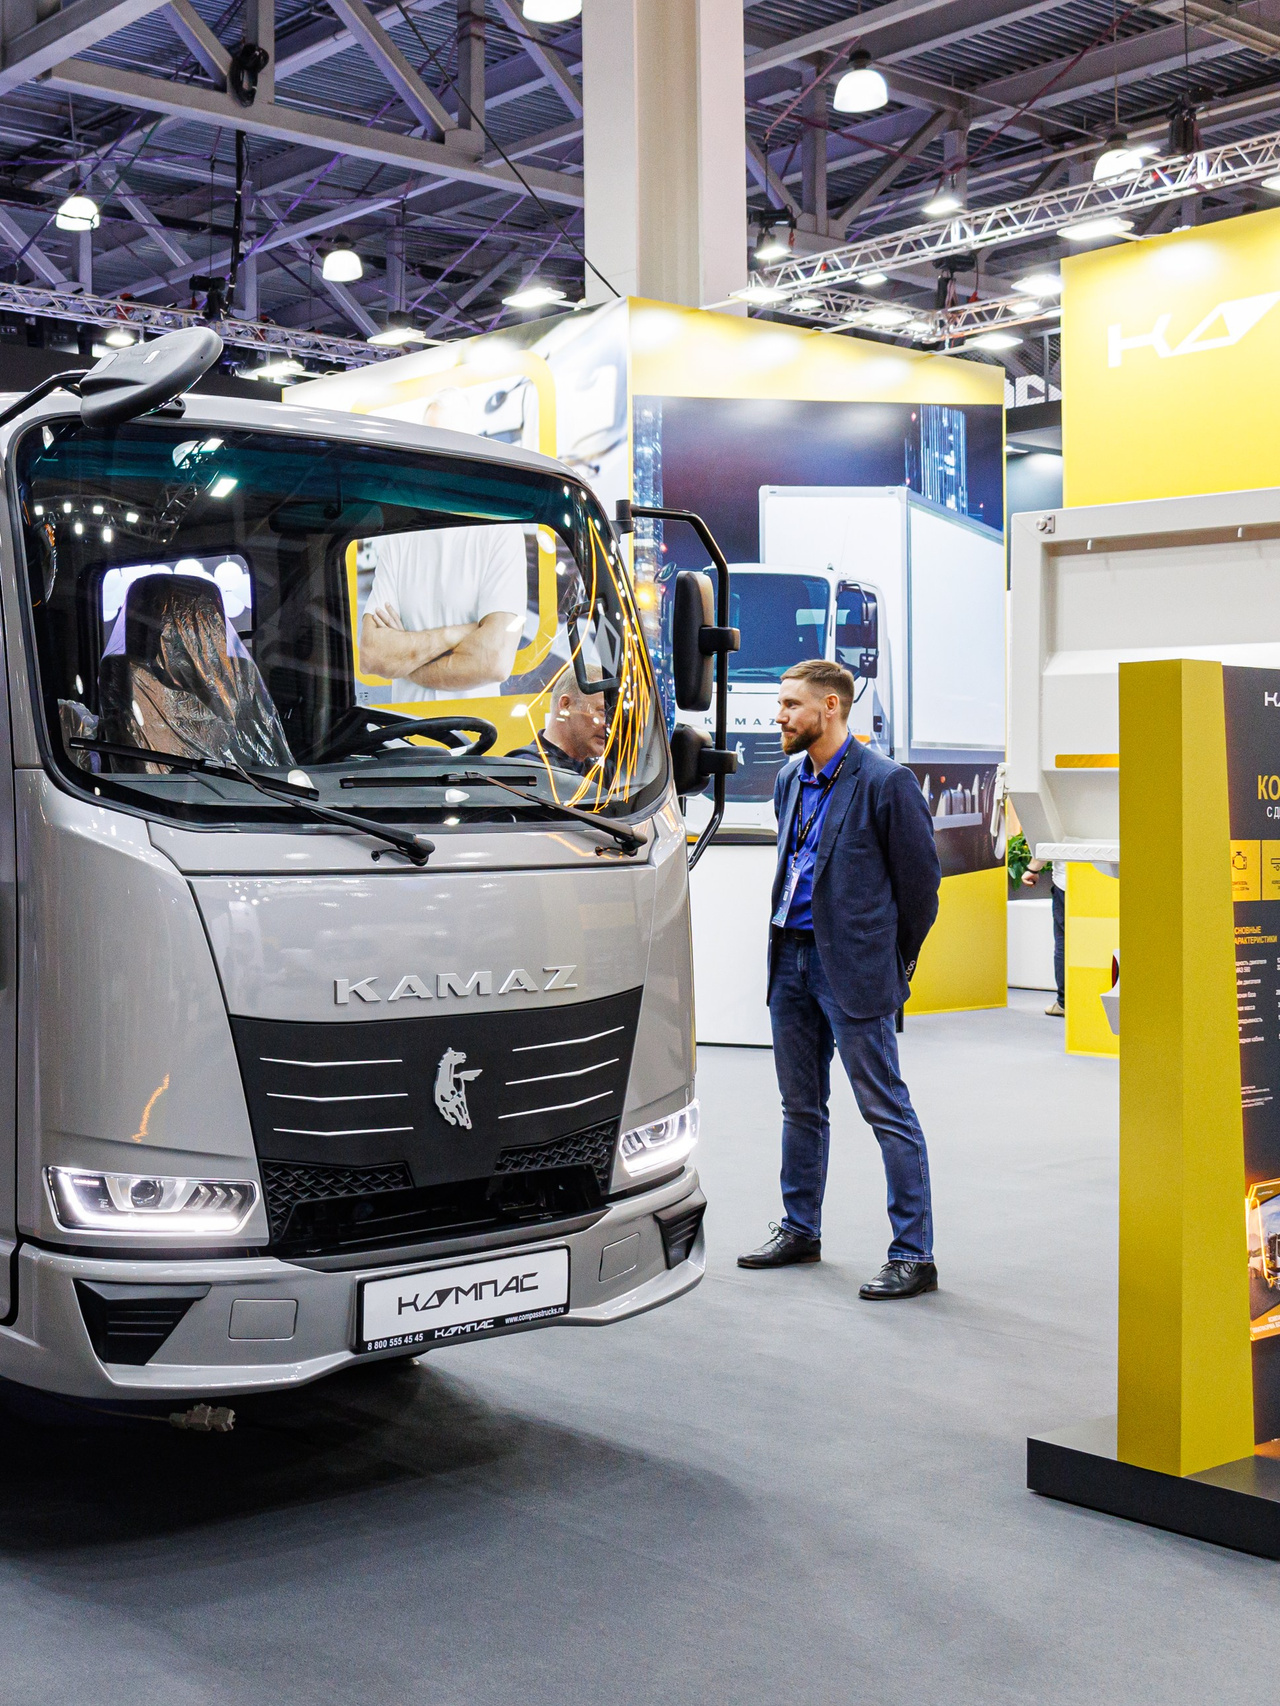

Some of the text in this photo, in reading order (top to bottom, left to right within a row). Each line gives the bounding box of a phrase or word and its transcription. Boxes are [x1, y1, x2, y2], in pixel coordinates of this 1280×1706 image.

[704, 717, 778, 726] KMAZ
[1234, 926, 1261, 934] СНОВНЫЕ
[1234, 935, 1278, 945] АРАКТЕРИСТИКИ
[334, 965, 578, 1004] KAMAZ
[505, 1307, 564, 1325] www.compasstrucks.ru
[367, 1332, 424, 1351] 8 800 555 45 45
